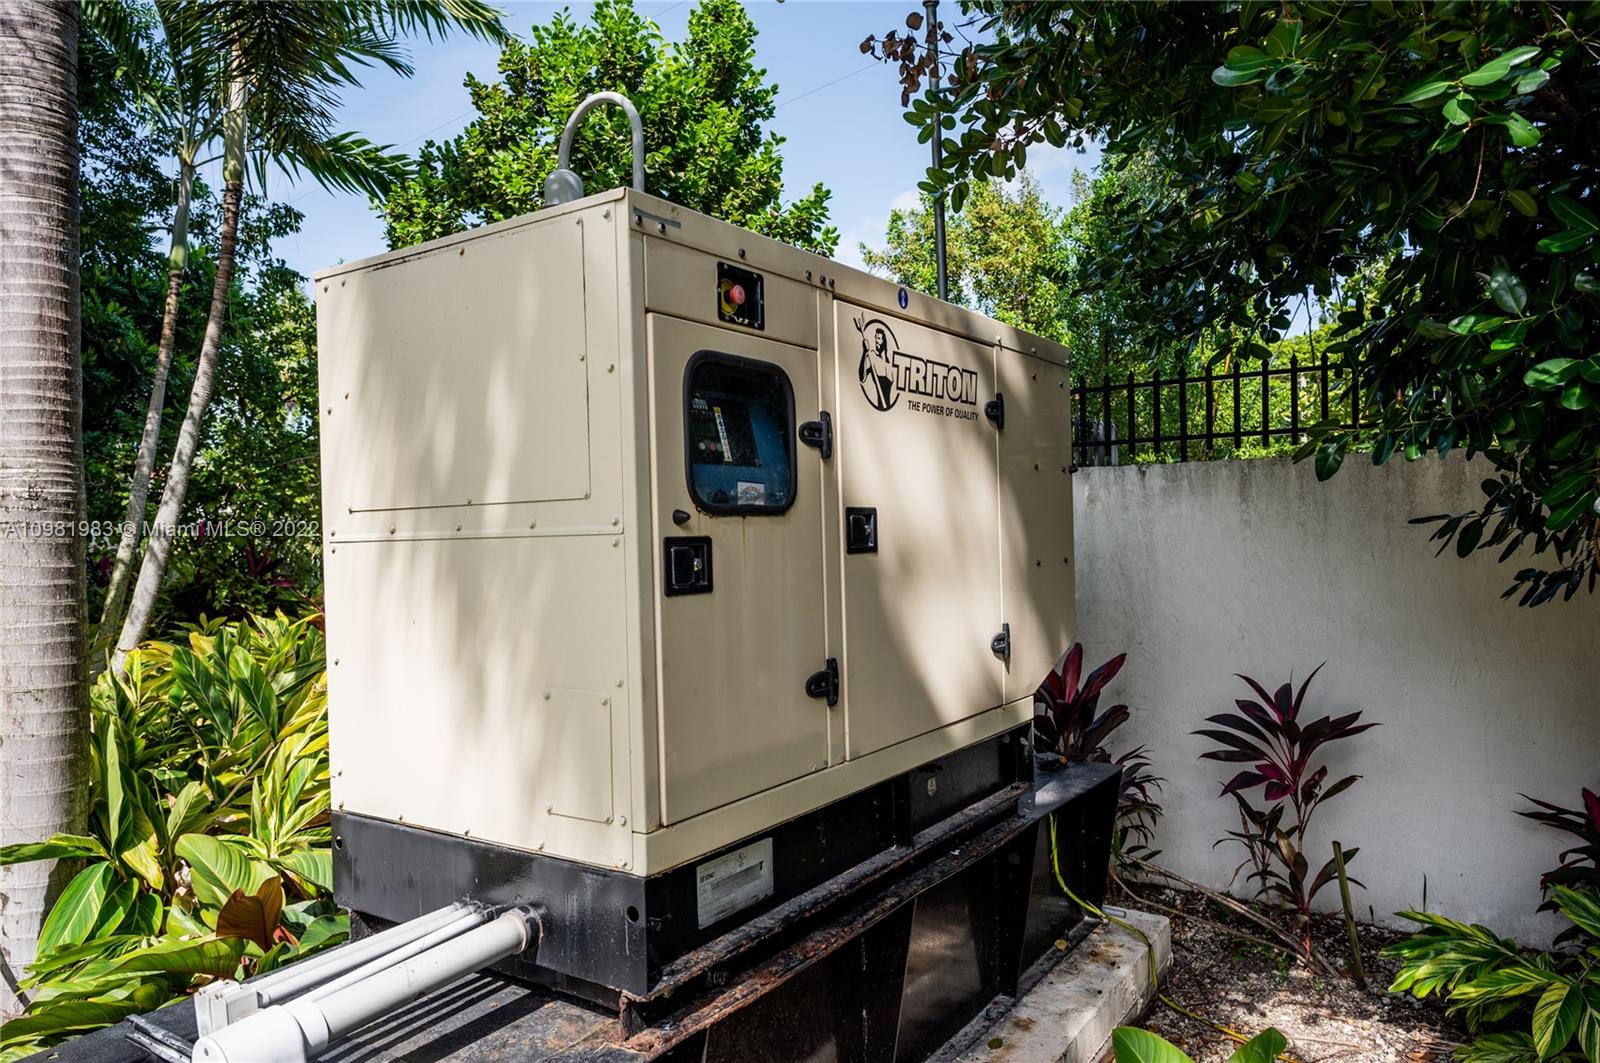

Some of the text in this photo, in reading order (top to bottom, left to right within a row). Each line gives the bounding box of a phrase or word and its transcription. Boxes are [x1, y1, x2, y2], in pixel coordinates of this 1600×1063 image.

[892, 351, 977, 405] TRITON
[908, 400, 979, 421] THE POWER OF QUALITY
